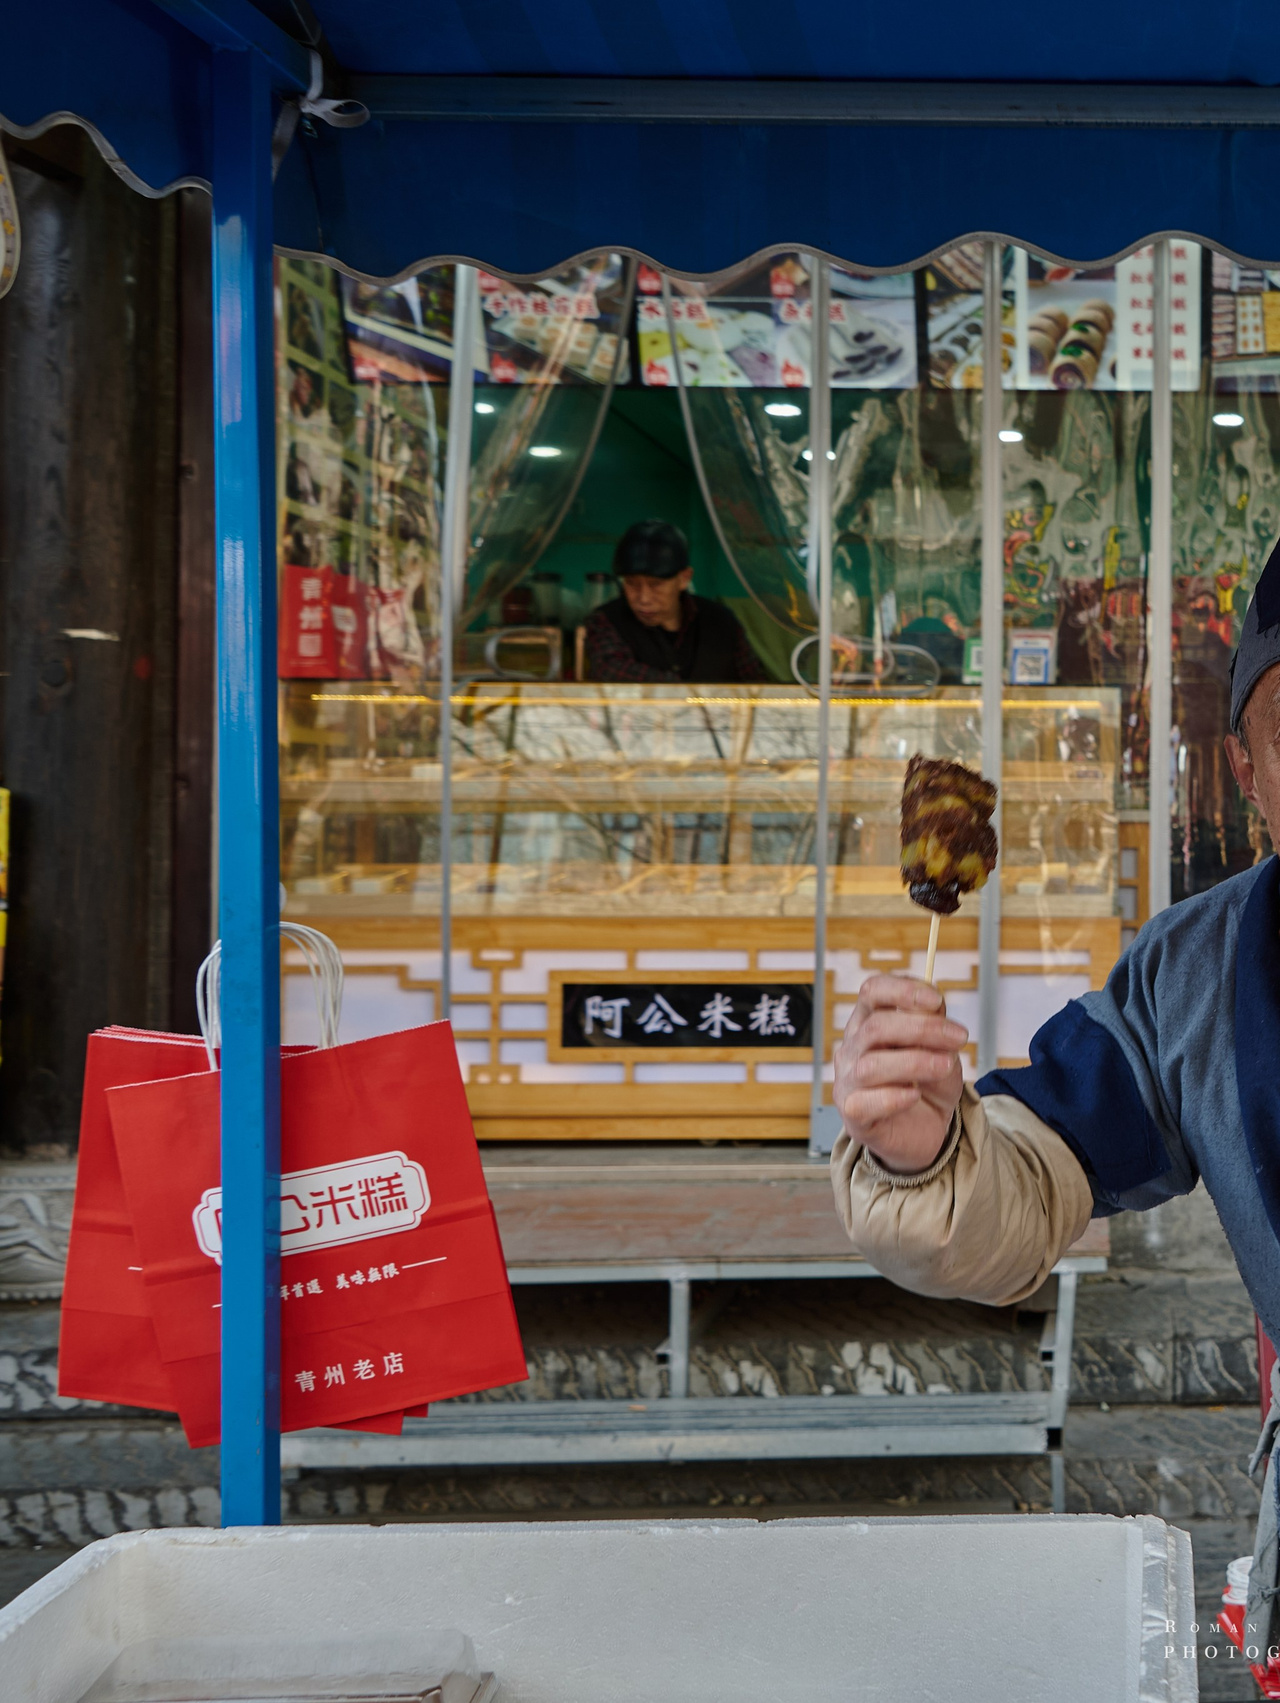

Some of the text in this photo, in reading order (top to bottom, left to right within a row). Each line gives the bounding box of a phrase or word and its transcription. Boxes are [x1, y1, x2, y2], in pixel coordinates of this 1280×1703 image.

[584, 993, 796, 1038] 阿公米糕
[213, 1172, 409, 1252] 公米糕
[294, 1352, 404, 1393] 青州老店
